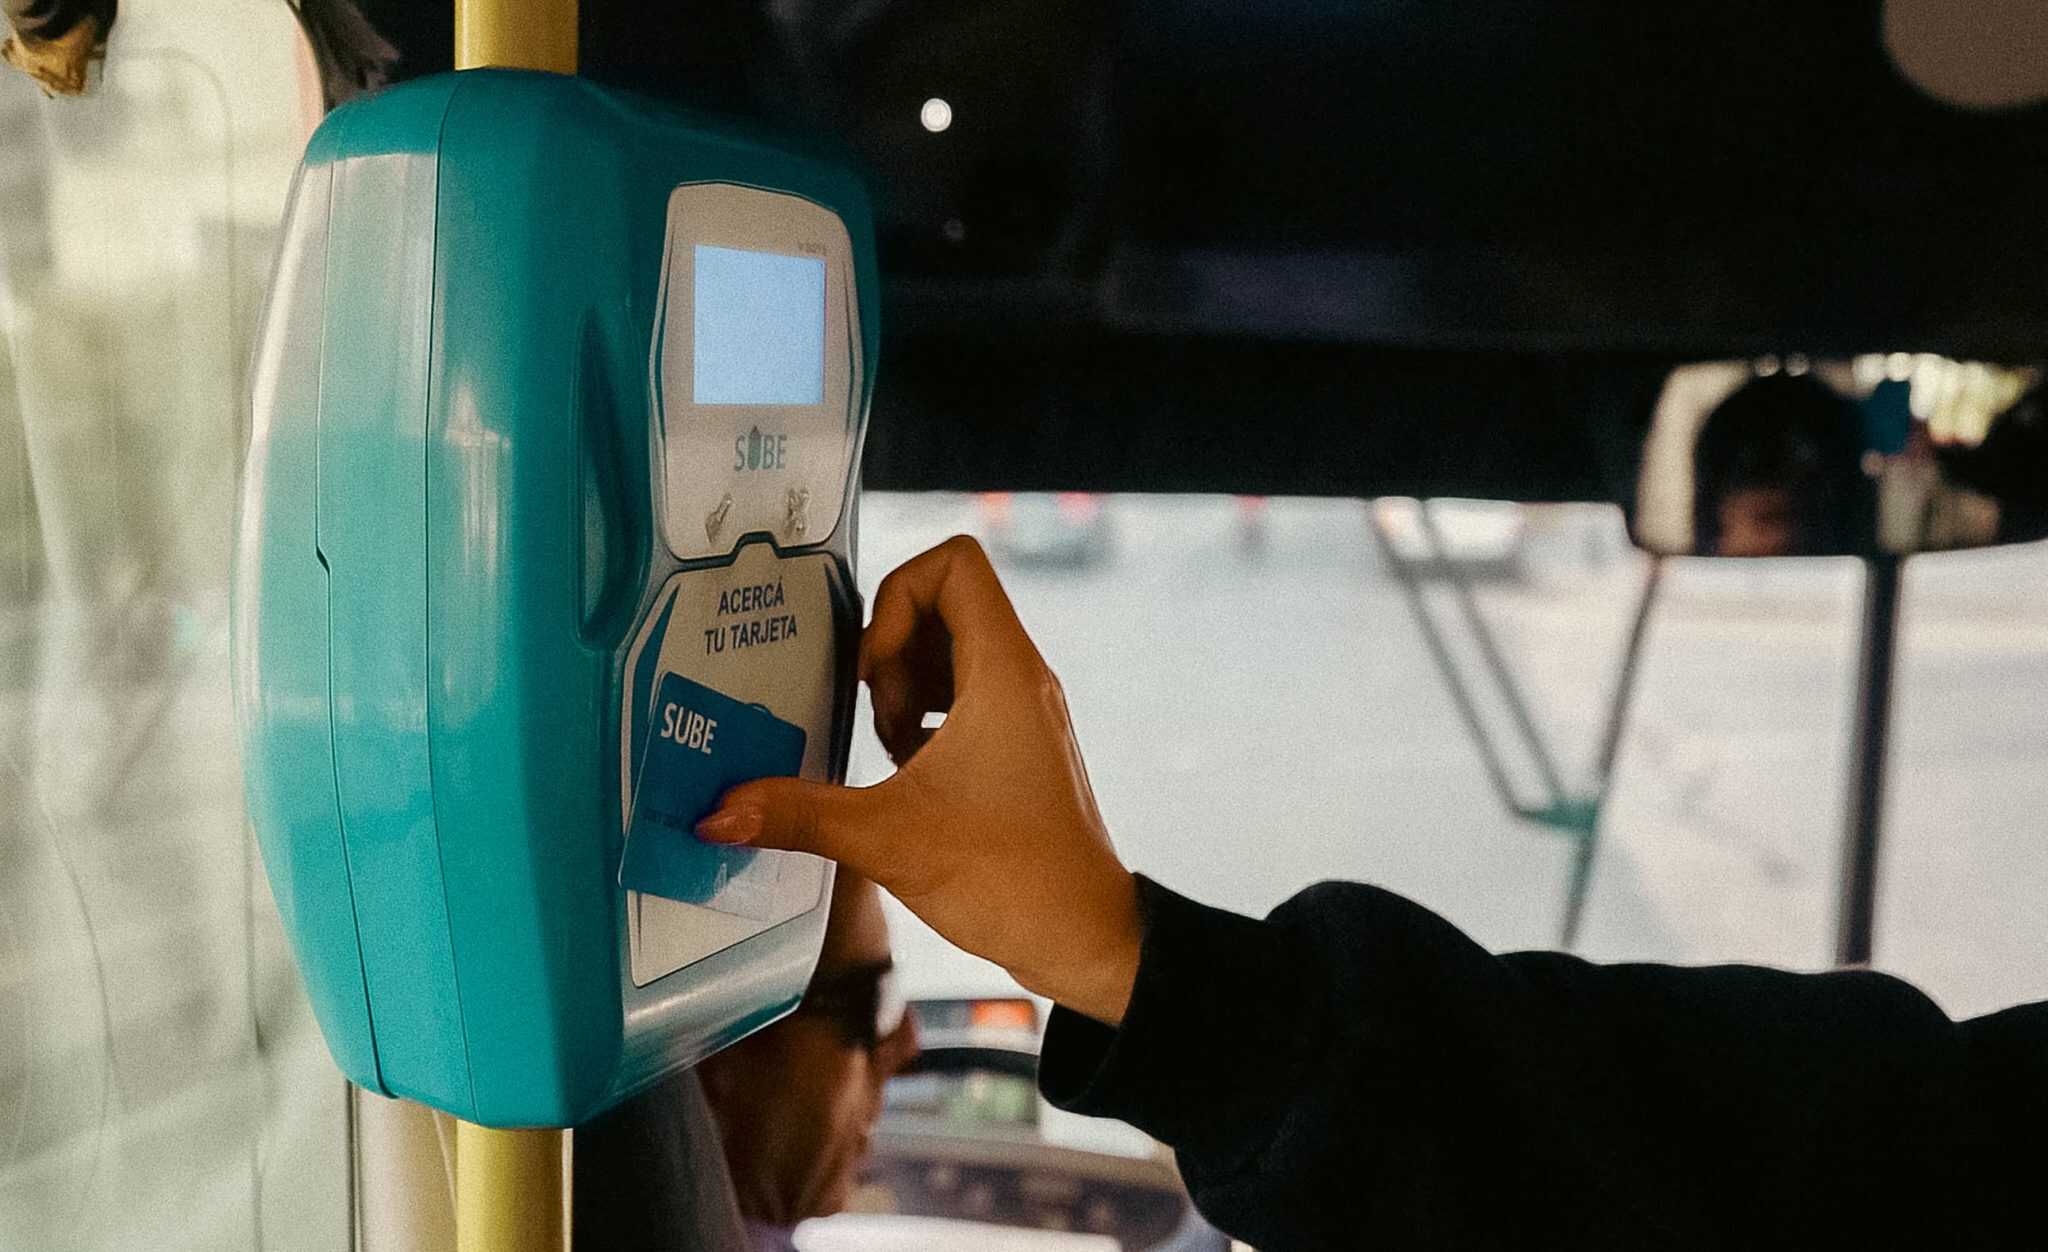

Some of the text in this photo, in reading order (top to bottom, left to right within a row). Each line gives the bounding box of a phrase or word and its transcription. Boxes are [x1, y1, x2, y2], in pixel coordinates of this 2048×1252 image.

[735, 428, 787, 471] SUBE
[718, 575, 785, 616] ACERCÁ
[704, 614, 798, 656] TU TARJETA
[660, 703, 717, 754] SUBE
